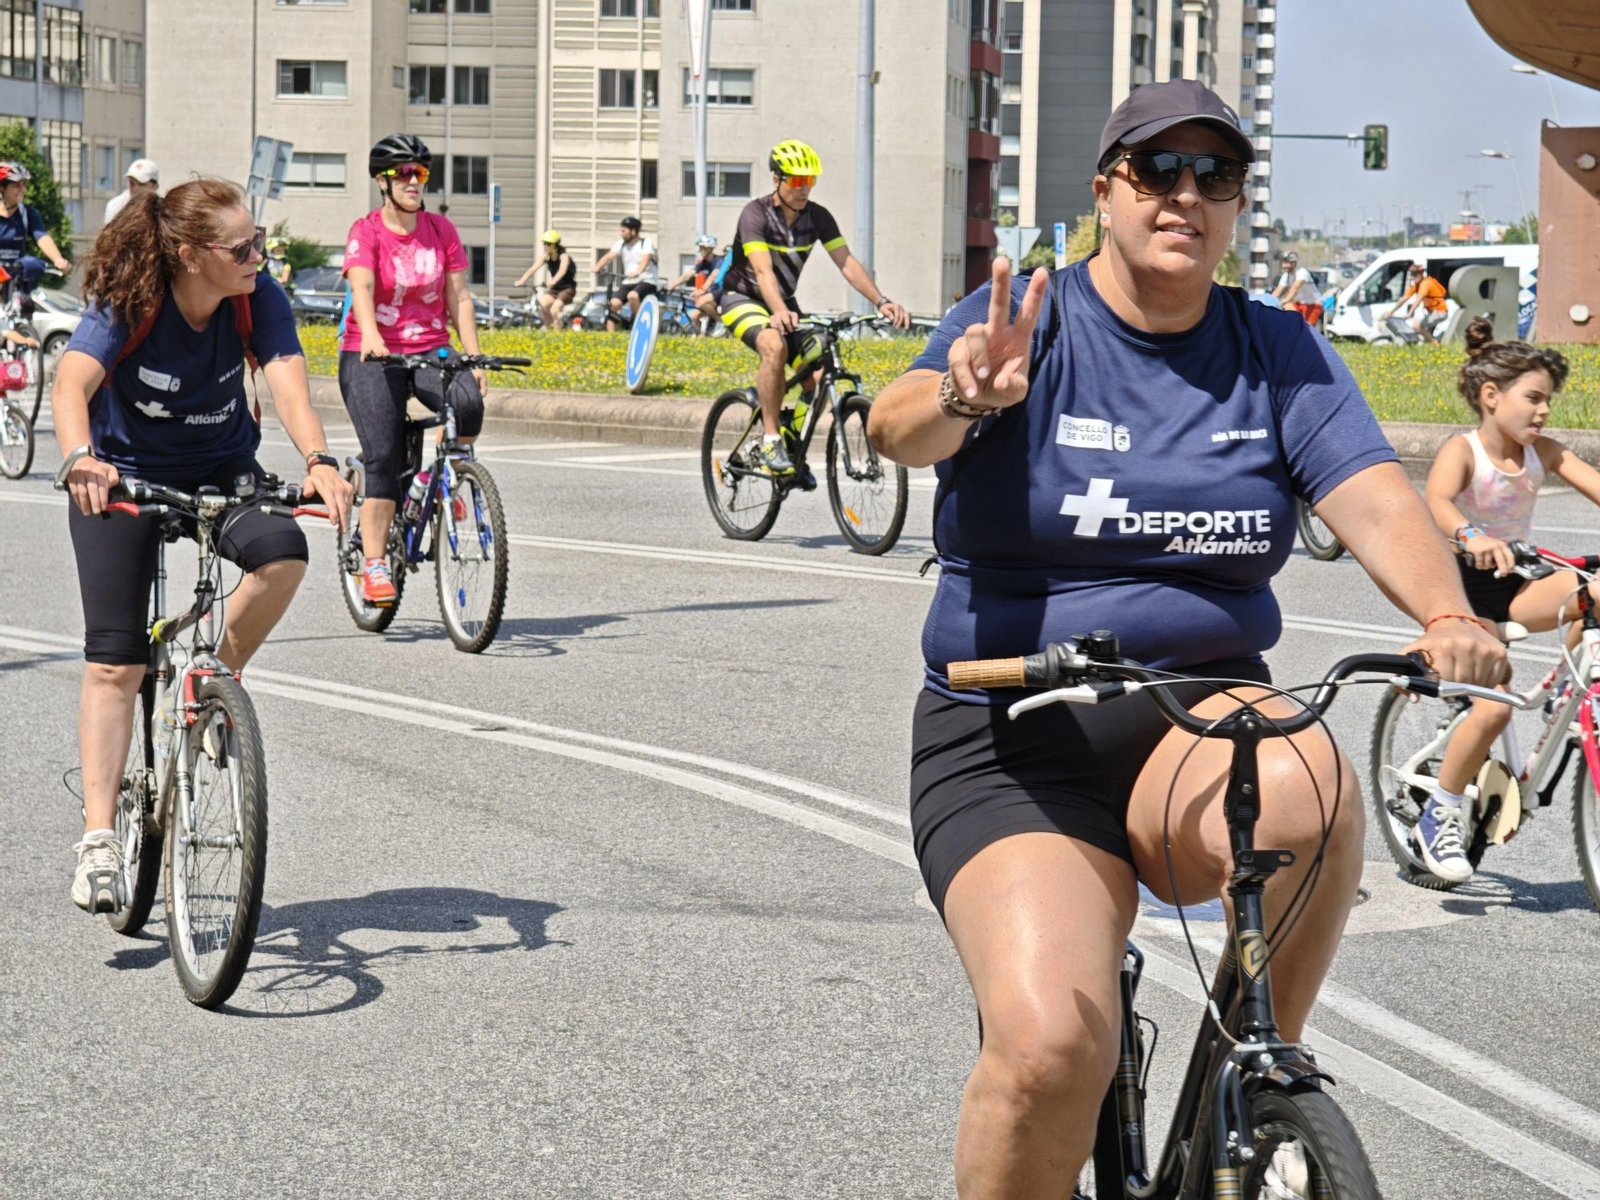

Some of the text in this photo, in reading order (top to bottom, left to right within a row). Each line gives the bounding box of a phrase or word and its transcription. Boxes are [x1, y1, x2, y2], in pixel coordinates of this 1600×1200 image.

[1062, 421, 1108, 434] CONCELLO
[1066, 431, 1103, 442] DE VIGO
[1118, 510, 1271, 534] DEPORTE
[1163, 534, 1271, 554] Atlántico
